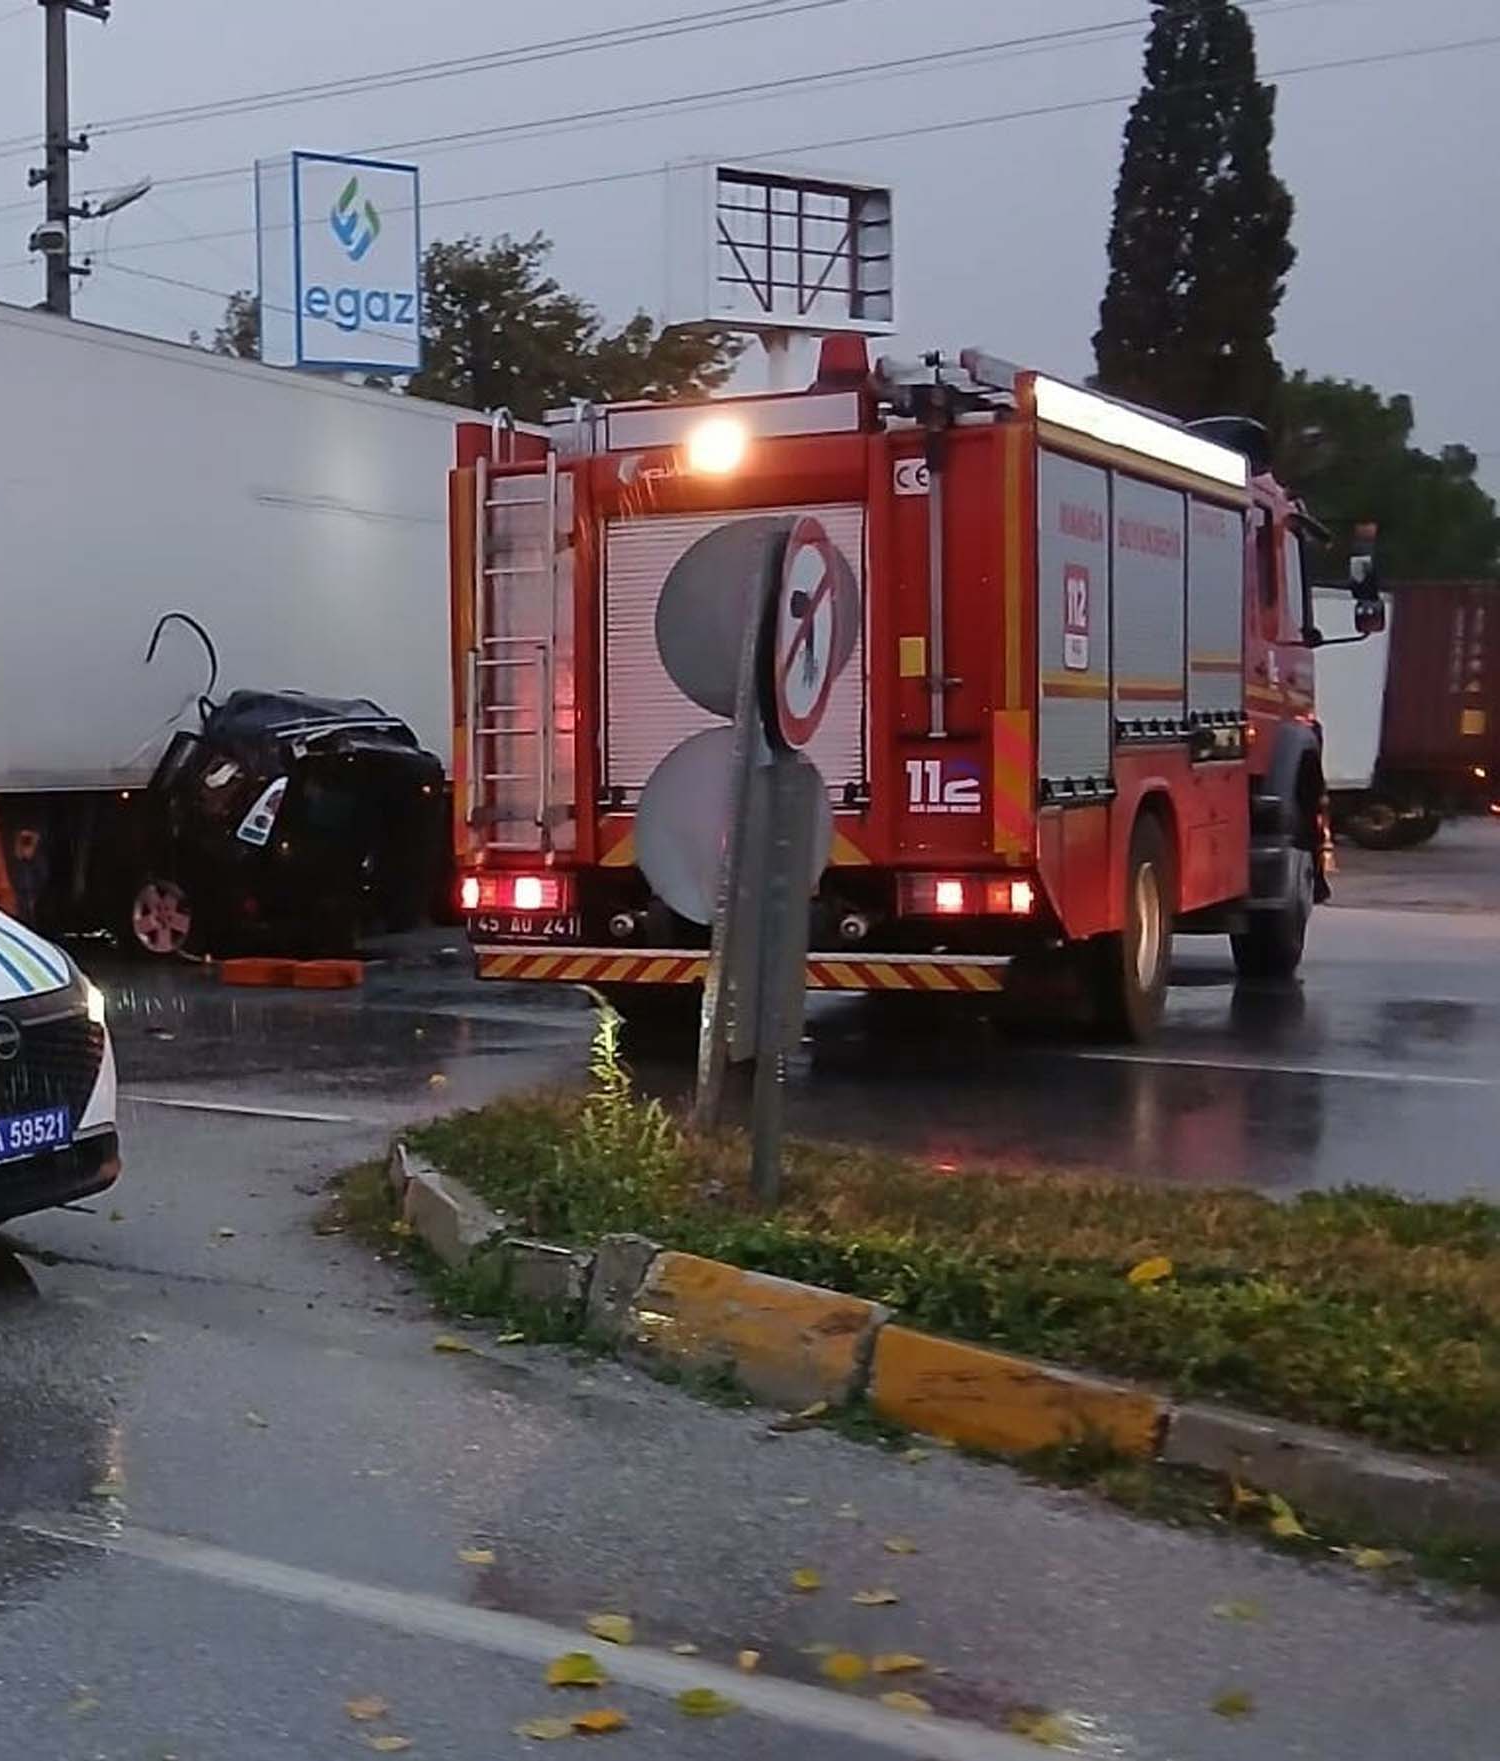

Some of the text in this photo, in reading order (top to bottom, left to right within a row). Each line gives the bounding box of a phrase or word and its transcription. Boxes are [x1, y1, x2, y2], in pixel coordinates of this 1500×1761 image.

[304, 286, 414, 332] egaz
[906, 760, 981, 803] 112
[478, 916, 500, 933] 45
[543, 917, 574, 935] 241
[10, 1111, 64, 1149] 59521
